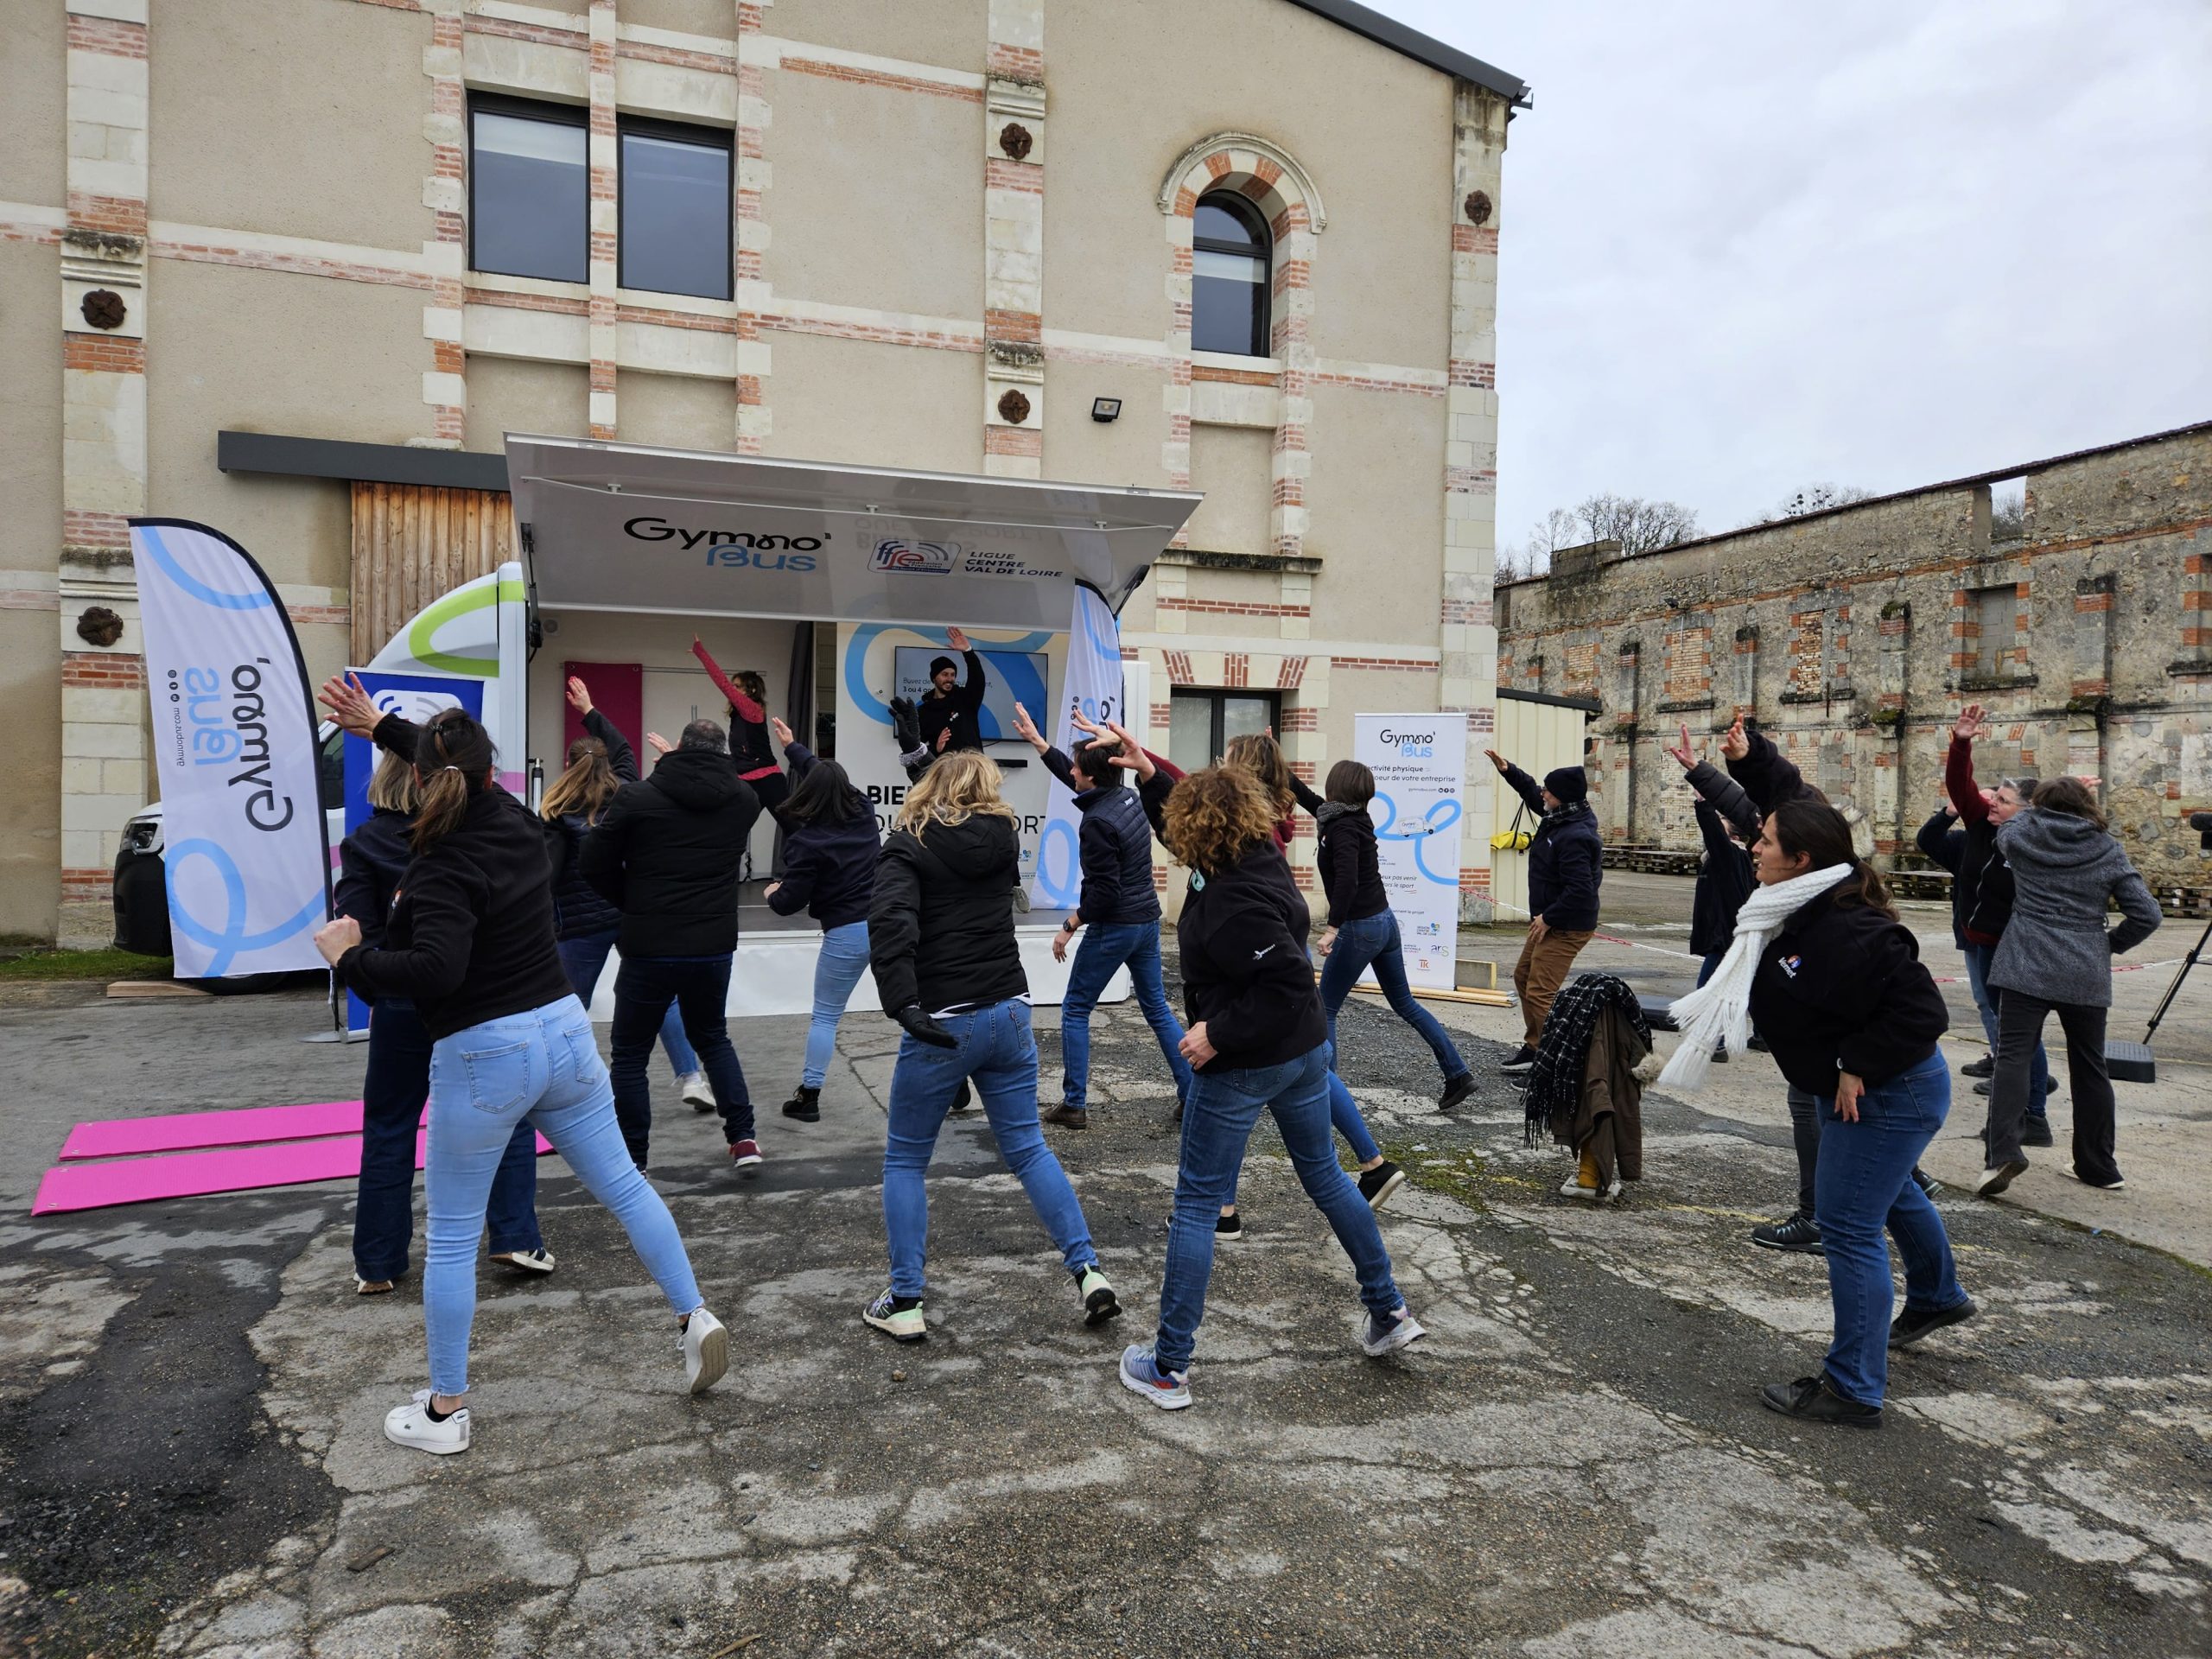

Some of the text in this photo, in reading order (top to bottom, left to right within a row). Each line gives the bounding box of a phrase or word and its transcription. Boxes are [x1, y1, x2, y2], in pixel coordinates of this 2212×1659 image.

[706, 543, 817, 572] Bus
[969, 551, 1016, 561] LIGUE
[966, 558, 1026, 569] CENTRE
[964, 566, 1065, 578] VAL DE LOIRE
[1402, 742, 1433, 758] Bus
[1392, 765, 1424, 773] physique
[868, 785, 913, 804] BIE
